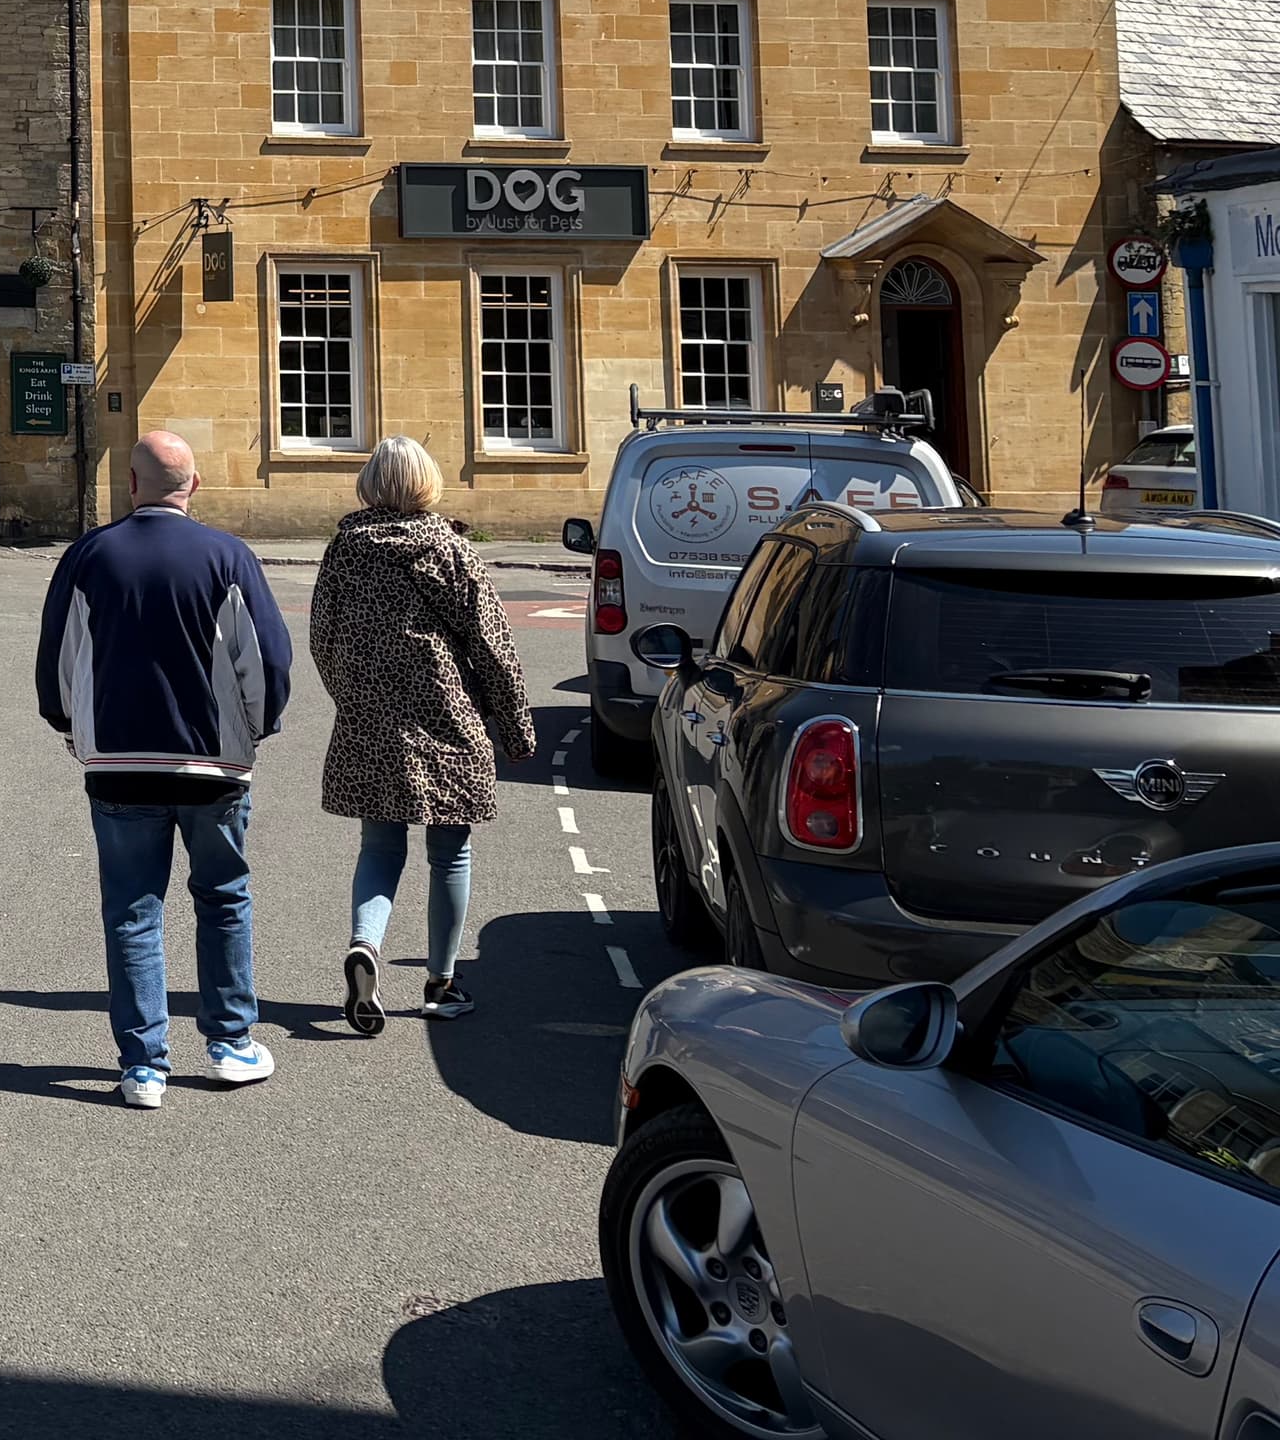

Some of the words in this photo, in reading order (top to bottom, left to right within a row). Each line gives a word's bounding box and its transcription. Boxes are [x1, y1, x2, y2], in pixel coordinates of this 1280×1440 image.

[466, 169, 585, 212] DOG
[466, 214, 483, 231] by
[487, 213, 519, 230] Just
[524, 214, 547, 230] for
[550, 214, 584, 230] Pets
[204, 252, 226, 271] DOG
[31, 378, 46, 387] Eat
[25, 391, 53, 400] Drink
[25, 404, 52, 416] Sleep
[668, 551, 718, 561] 07538
[1140, 778, 1180, 792] MINI
